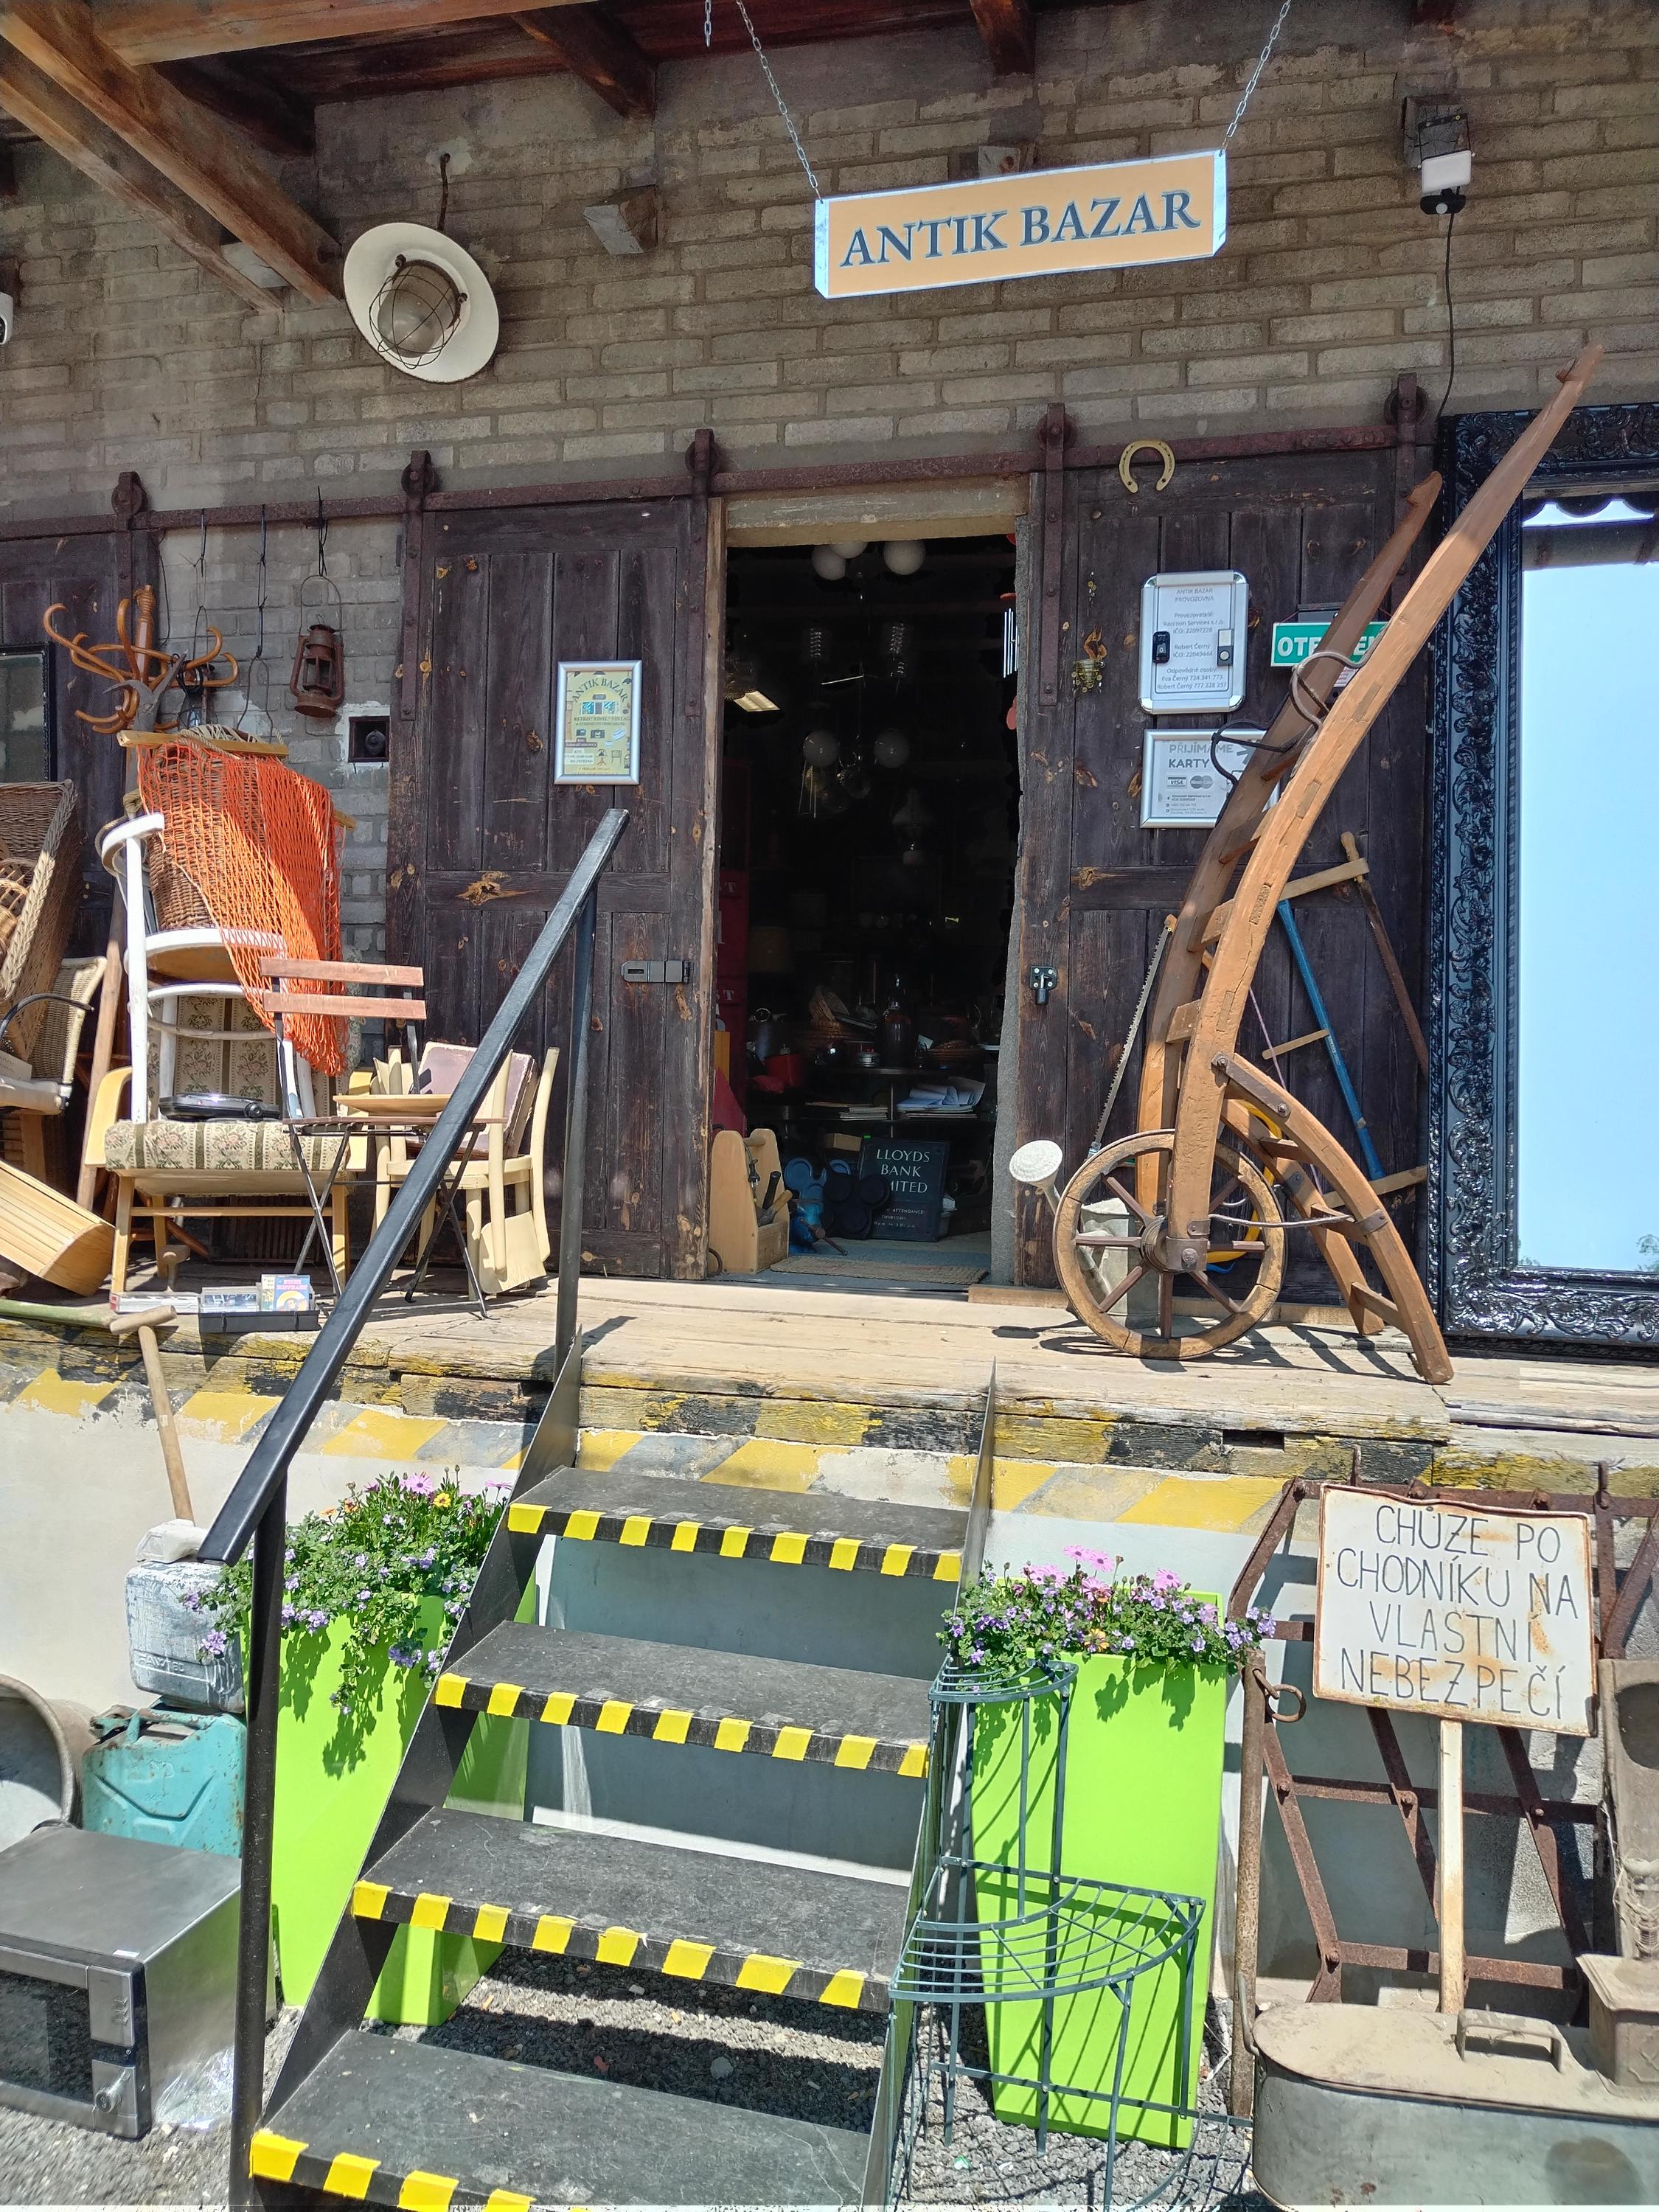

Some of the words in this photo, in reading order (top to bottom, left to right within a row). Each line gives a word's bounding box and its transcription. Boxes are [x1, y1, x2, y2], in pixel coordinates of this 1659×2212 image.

[839, 210, 1008, 268] ANTIK
[1020, 189, 1203, 248] BAZAR
[572, 678, 600, 703] ANTIK
[601, 678, 628, 703] BAZAR
[1169, 742, 1234, 754] PŘIJÍMME
[1168, 759, 1210, 768] KARTY
[877, 1149, 931, 1163] LLOYDS
[881, 1164, 921, 1178] BANK
[1376, 1505, 1489, 1557] CHŮZE
[1516, 1522, 1561, 1563] PO
[1337, 1548, 1511, 1607] CHODNÍKU
[1528, 1572, 1579, 1619] NA
[1341, 1648, 1567, 1719] NEBEZPEČÍ
